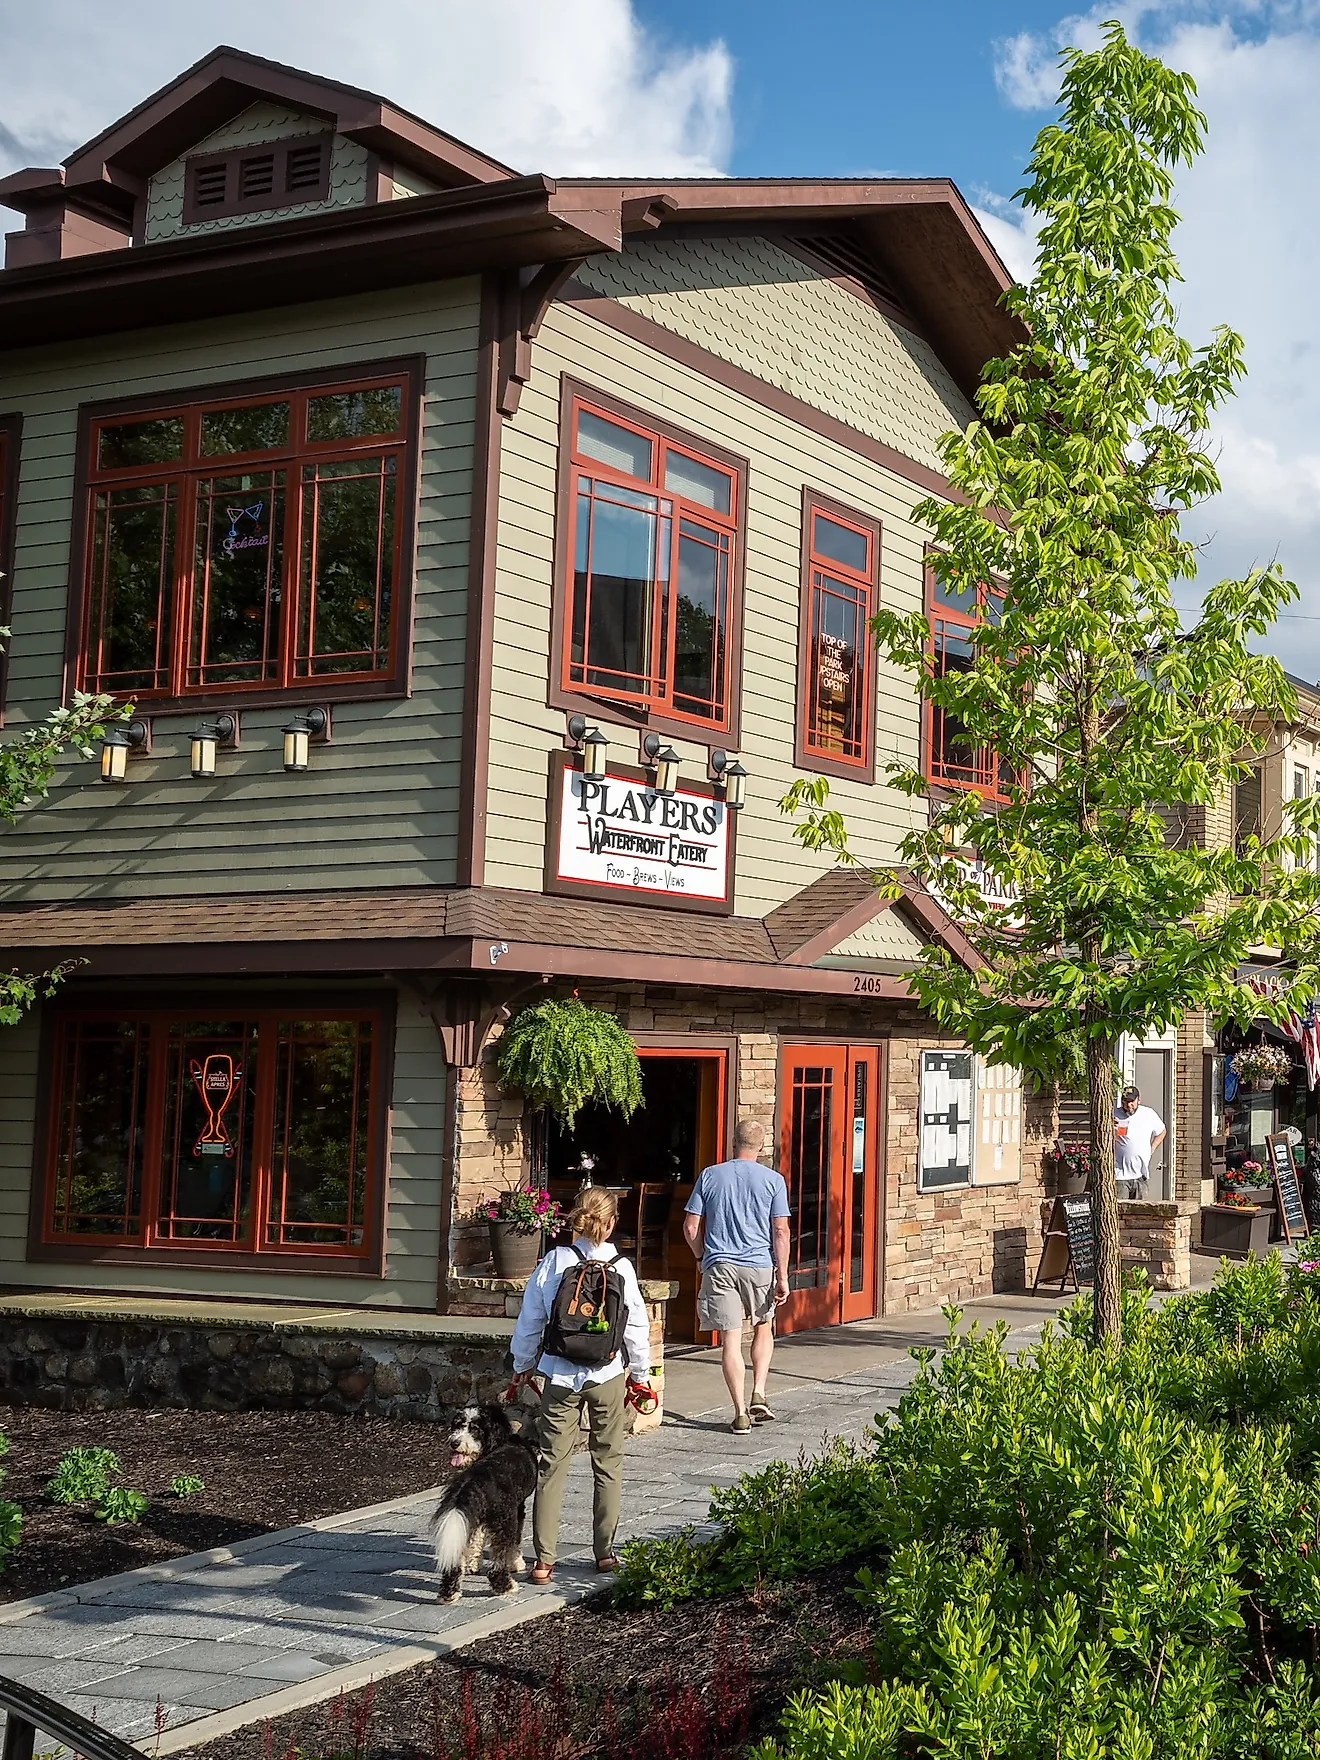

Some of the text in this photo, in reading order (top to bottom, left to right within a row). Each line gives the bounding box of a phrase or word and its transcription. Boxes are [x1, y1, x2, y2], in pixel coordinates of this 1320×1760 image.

[821, 632, 848, 650] TOP OF
[827, 646, 842, 660] THE
[824, 655, 843, 671] PARK
[823, 677, 843, 692] OPEN
[577, 779, 718, 836] PLAYERS
[586, 813, 666, 856] WATERFRONT
[853, 976, 881, 993] 2405
